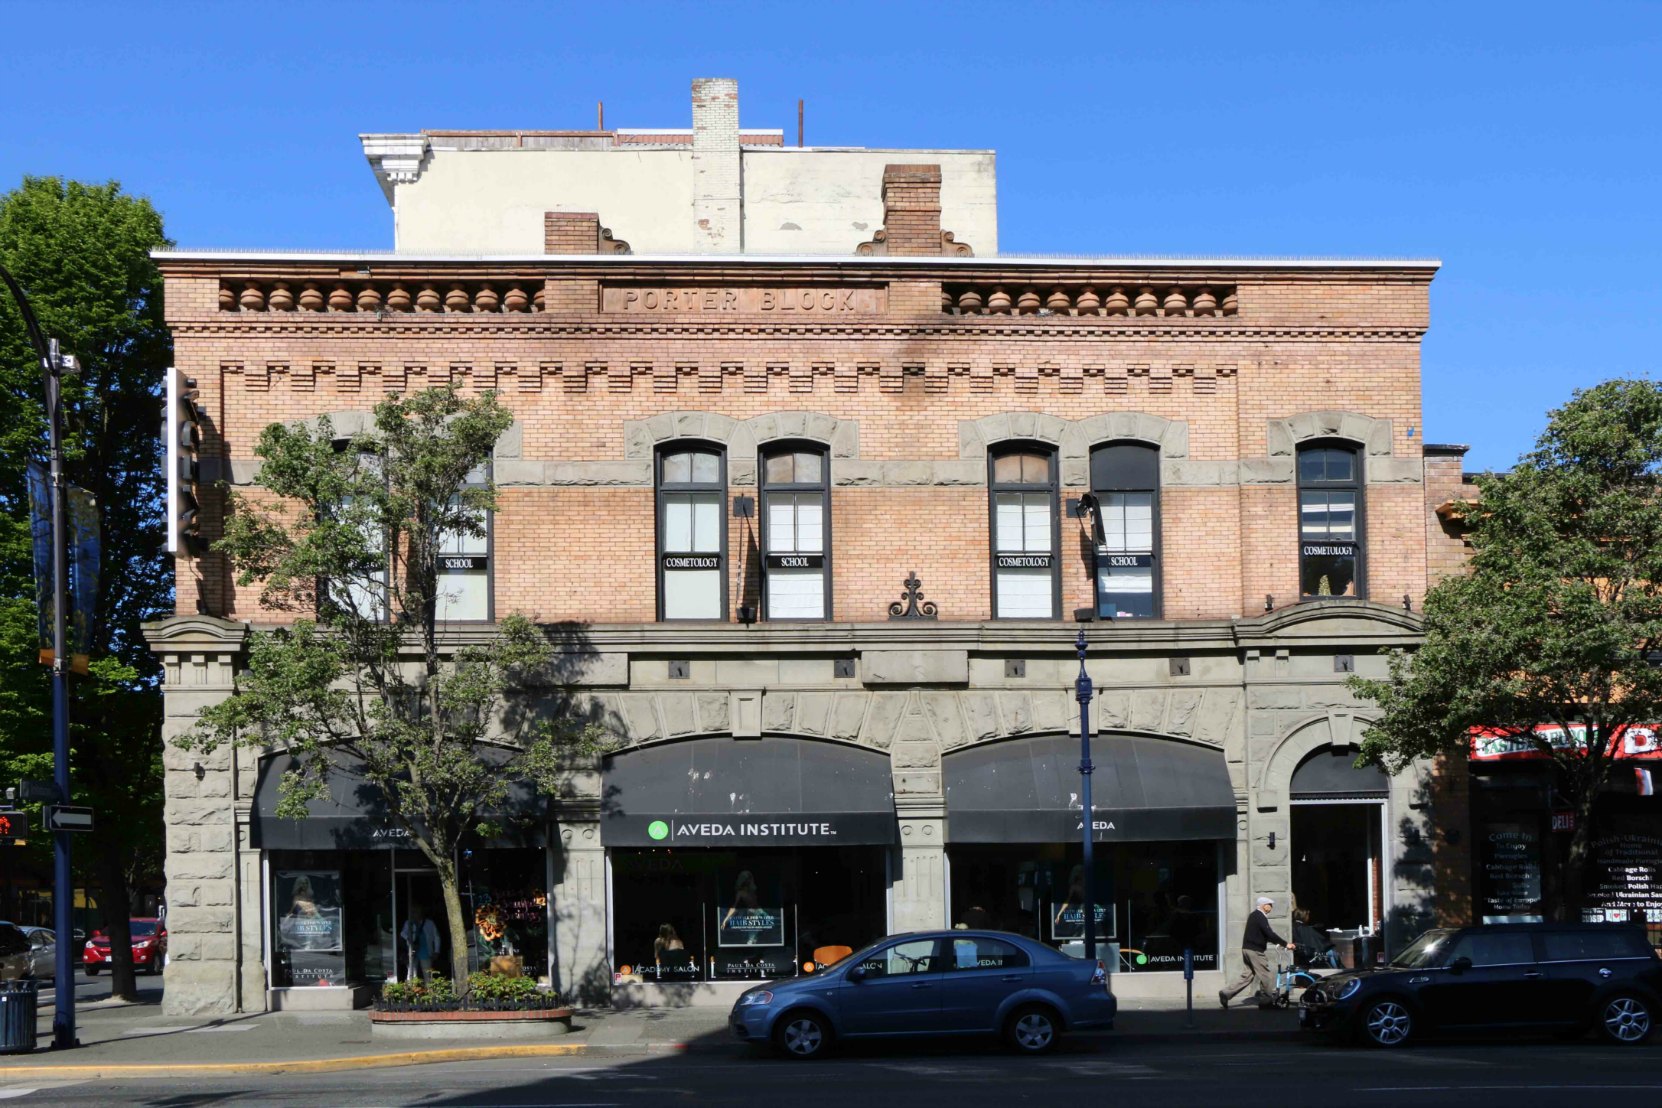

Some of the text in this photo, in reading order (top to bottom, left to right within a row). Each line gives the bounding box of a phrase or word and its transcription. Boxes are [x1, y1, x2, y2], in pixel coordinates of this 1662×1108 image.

[623, 291, 856, 312] PORTER BLOCK
[1303, 546, 1353, 556] COSMETOLOGY
[445, 558, 474, 569] SCHOOL
[666, 557, 718, 568] COSMETOLOGY
[780, 556, 809, 567] SCHOOL
[998, 556, 1050, 567] COSMETOLOGY
[1110, 556, 1138, 567] SCHOOL
[1077, 821, 1115, 830] AEDA
[1552, 815, 1569, 830] DELI
[676, 824, 736, 836] AVEDA
[740, 823, 830, 836] INSTITUTE
[1150, 955, 1176, 963] AVEDA
